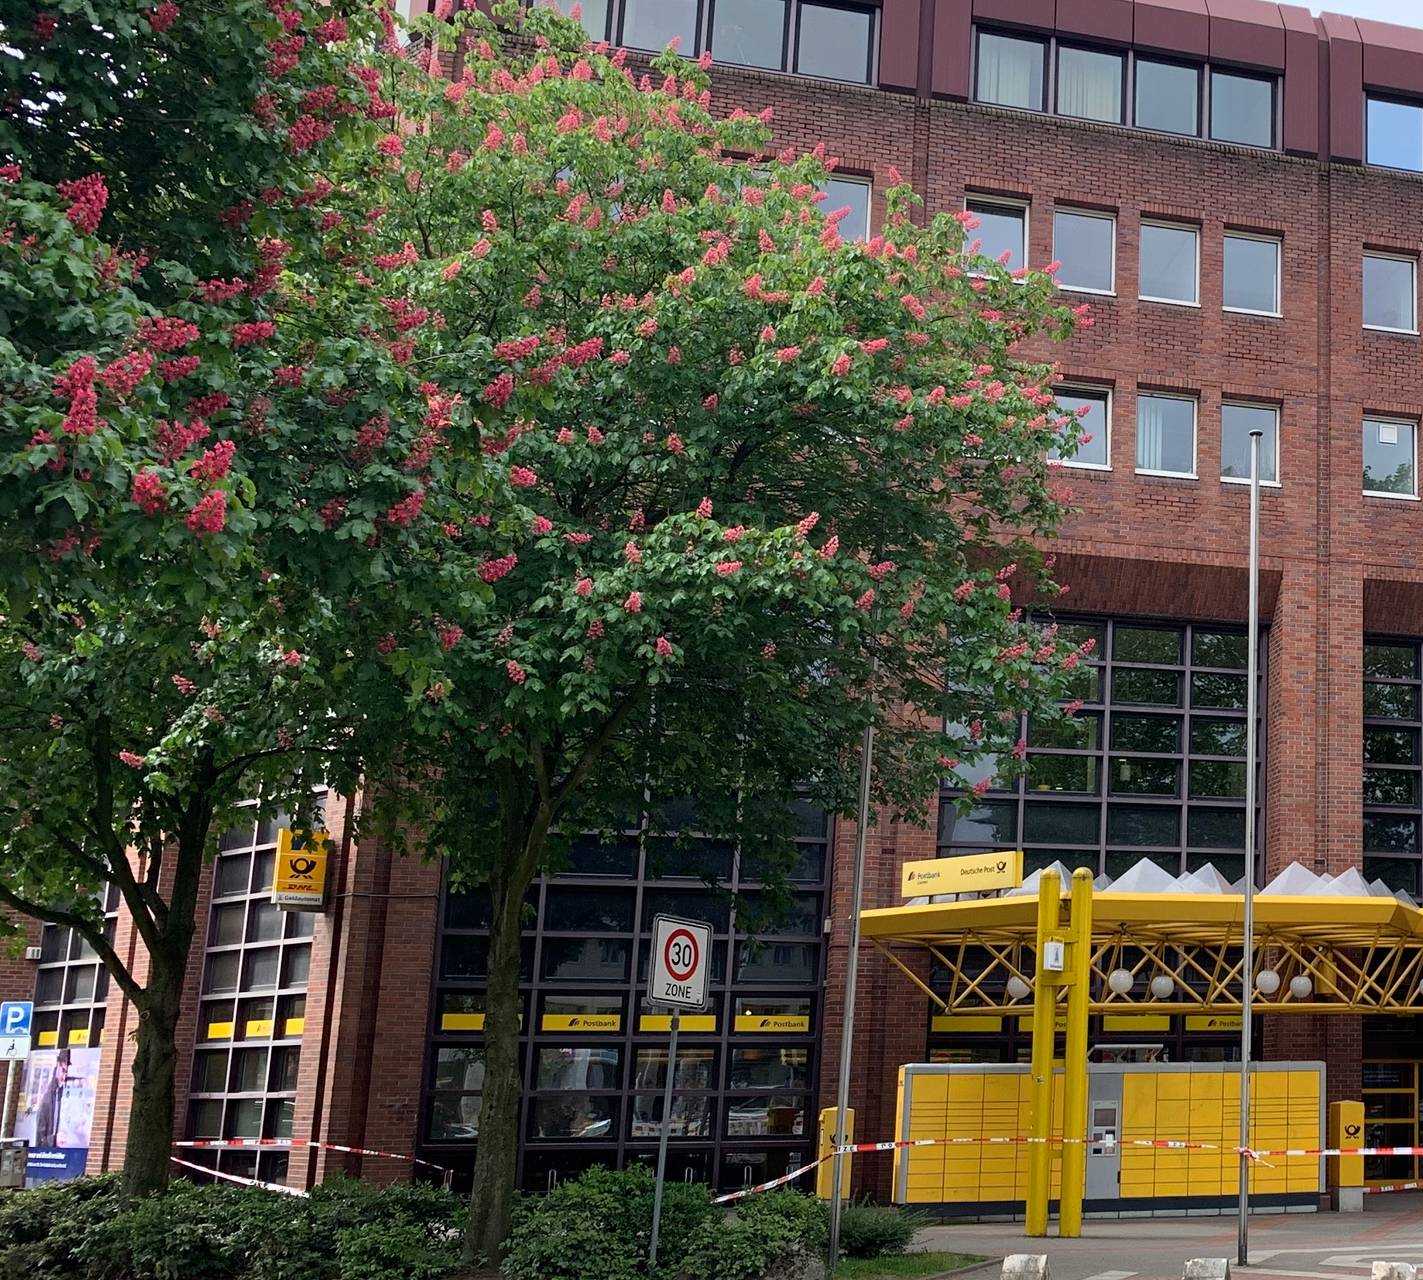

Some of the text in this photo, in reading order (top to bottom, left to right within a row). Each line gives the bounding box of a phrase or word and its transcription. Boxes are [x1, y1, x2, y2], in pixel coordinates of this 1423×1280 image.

[917, 871, 941, 880] Postbank
[960, 865, 995, 876] Deutsche Post
[284, 894, 321, 903] Geldautomat
[671, 942, 692, 968] 30
[665, 982, 693, 999] ZONE
[5, 1006, 25, 1034] P
[583, 1019, 617, 1027] Postbank
[773, 1020, 804, 1028] Postbank
